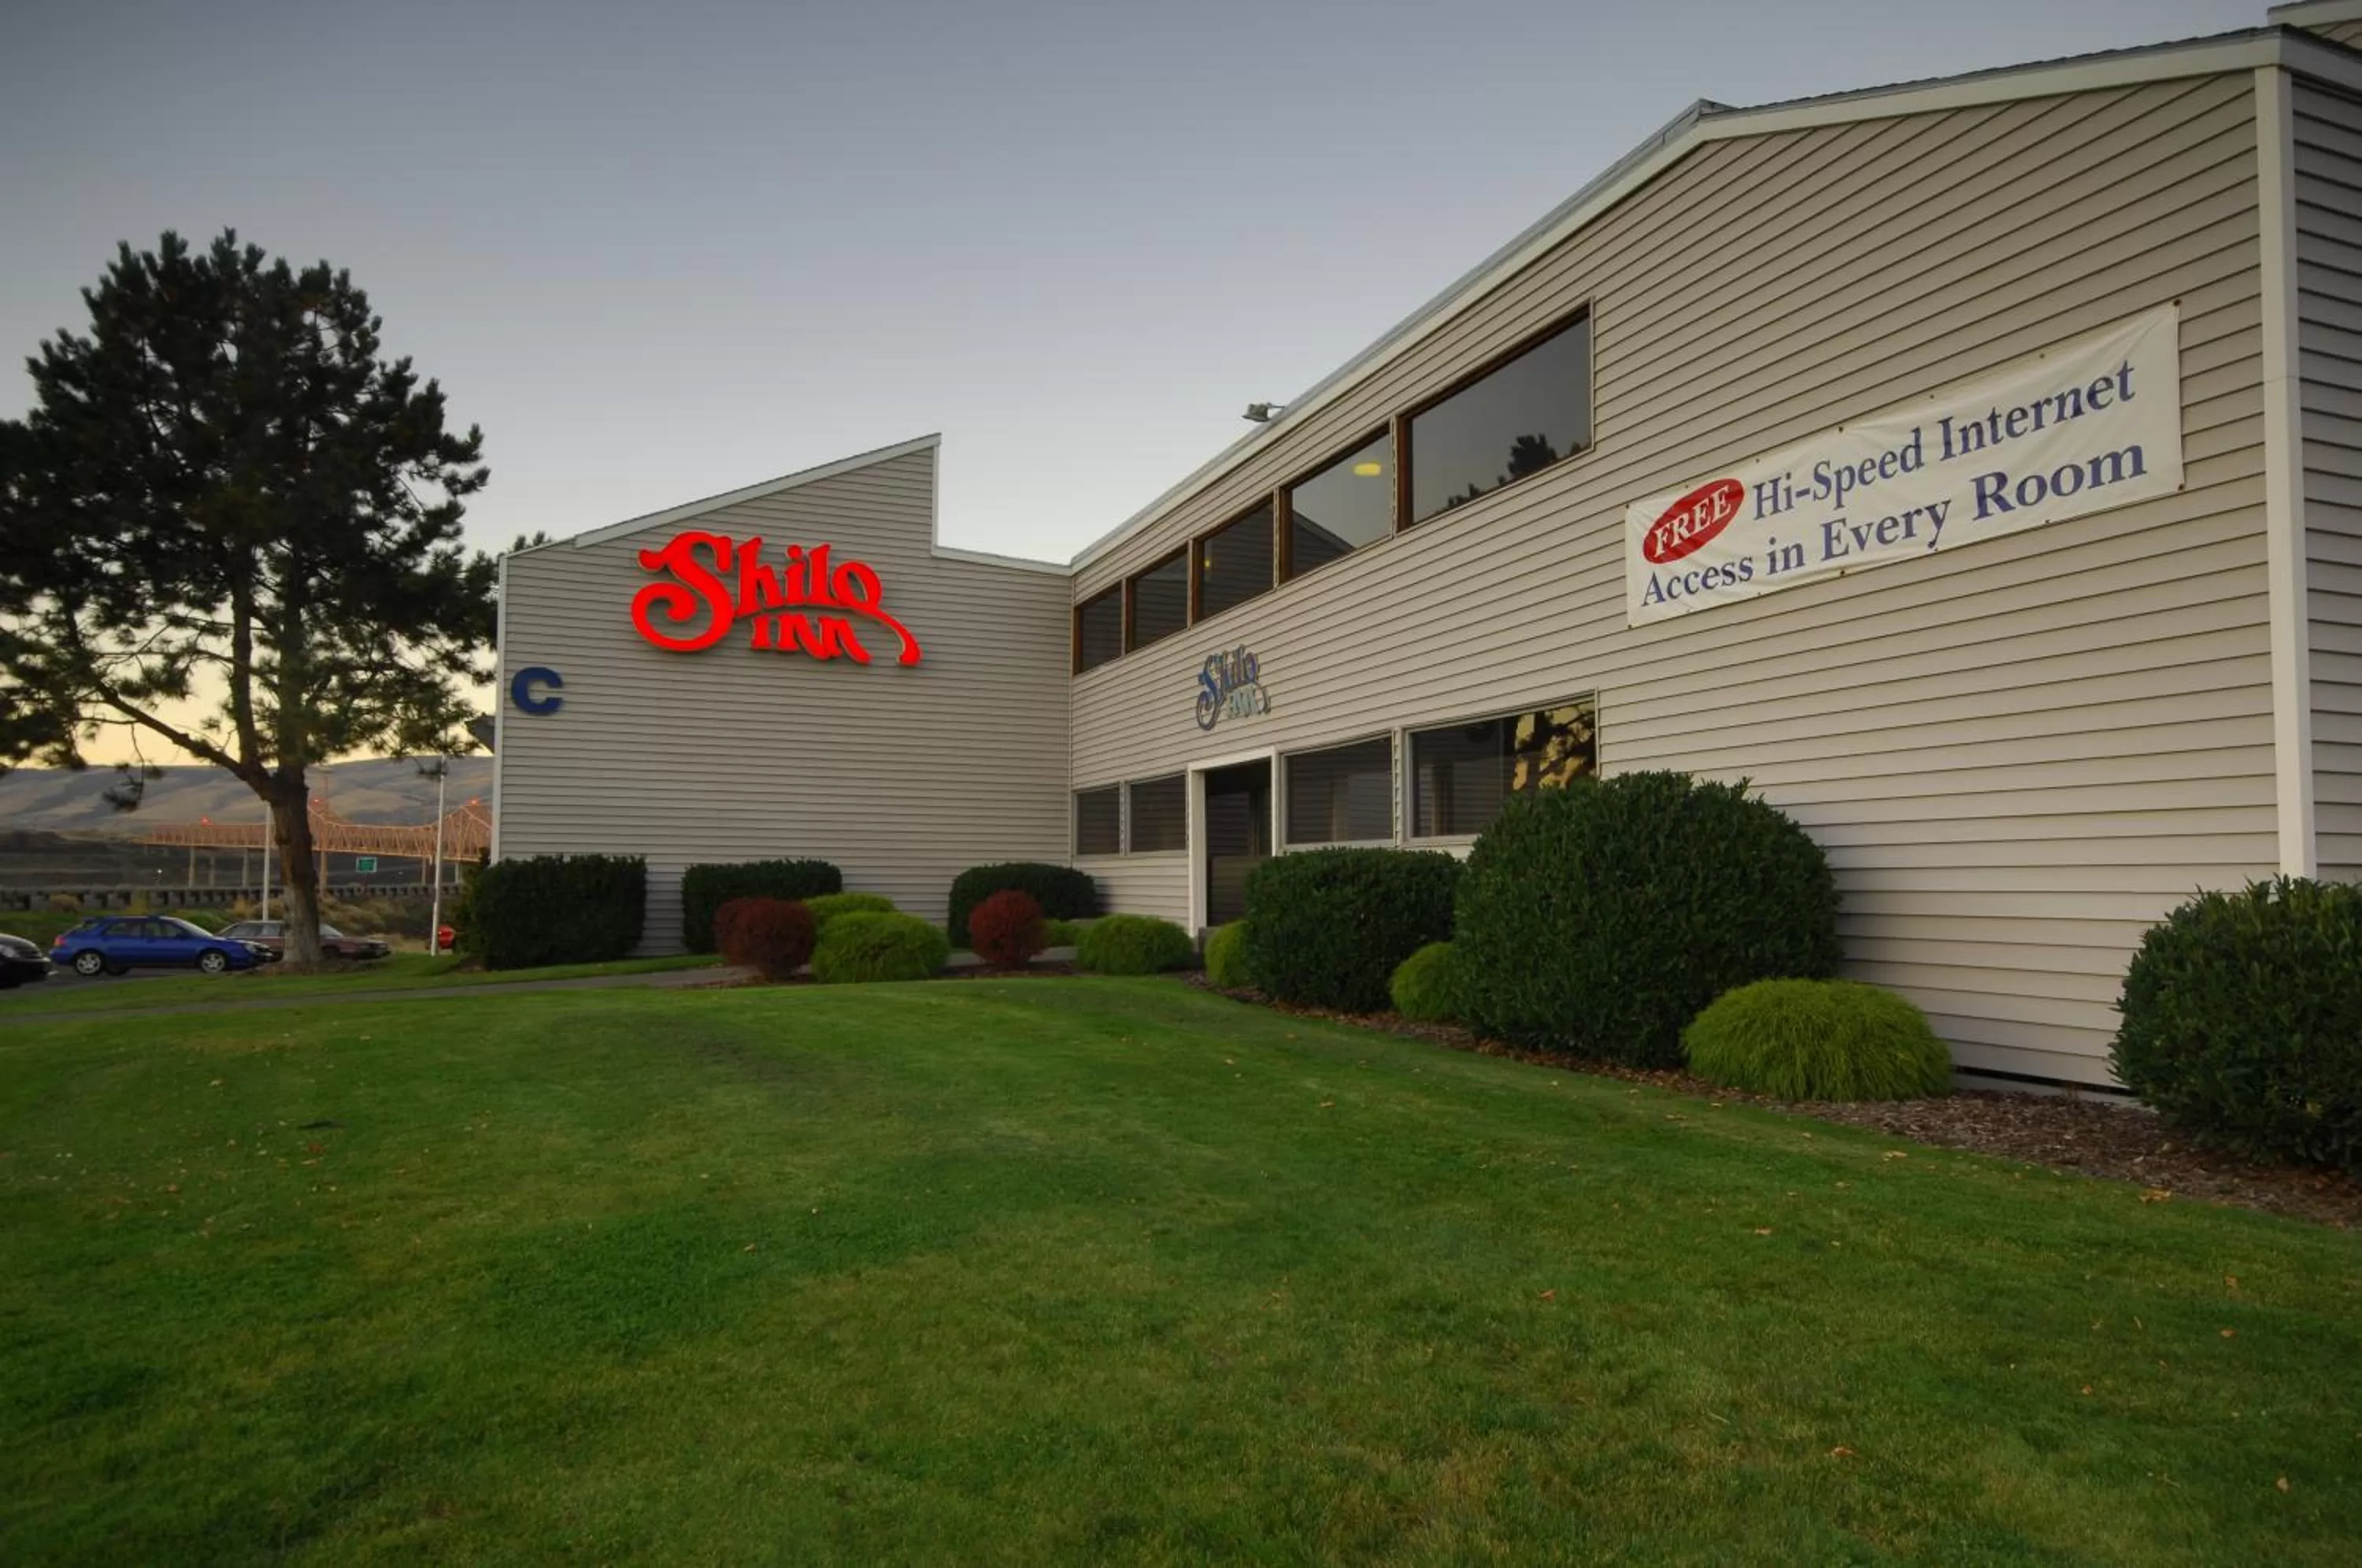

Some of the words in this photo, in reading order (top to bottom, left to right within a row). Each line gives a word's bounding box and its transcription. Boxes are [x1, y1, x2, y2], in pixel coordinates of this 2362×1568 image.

[1753, 428, 1925, 520] Hi-Speed
[1938, 360, 2137, 462] Internet
[1641, 556, 1754, 606] Access
[1767, 537, 1805, 575] in
[1820, 498, 1952, 561] Every
[1970, 443, 2148, 521] Room
[1653, 484, 1732, 558] FREE
[631, 531, 921, 666] Shilo
[511, 668, 563, 716] C
[1197, 644, 1271, 730] Shilo
